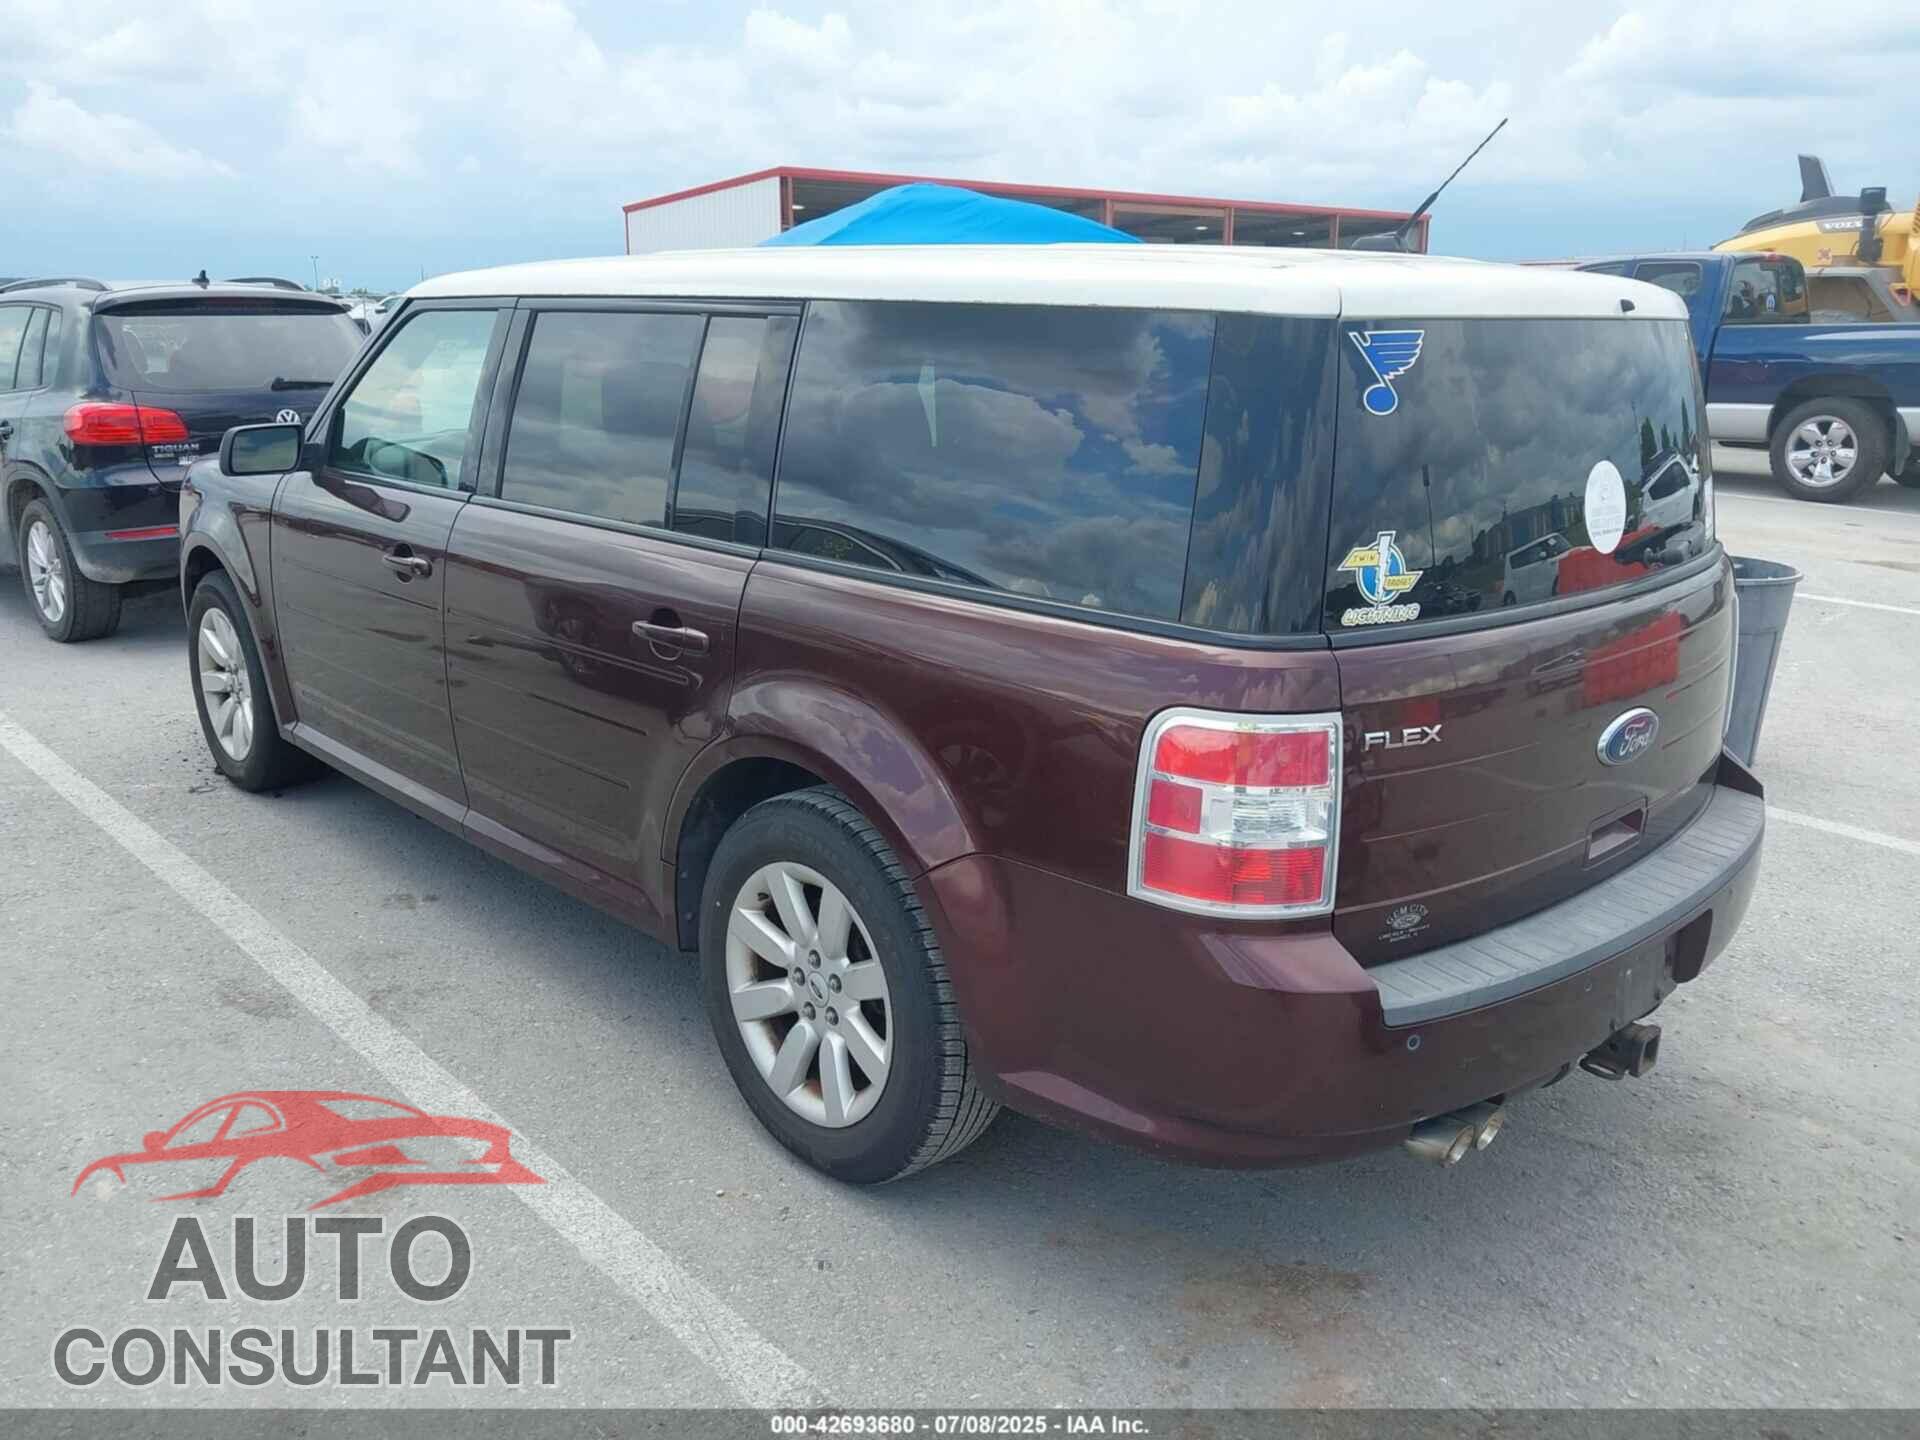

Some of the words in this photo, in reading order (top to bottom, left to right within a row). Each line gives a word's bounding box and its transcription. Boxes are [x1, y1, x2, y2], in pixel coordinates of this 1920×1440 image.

[1823, 221, 1863, 230] VOLV
[1342, 603, 1420, 625] LIGHTNING
[1364, 724, 1442, 751] FLEX
